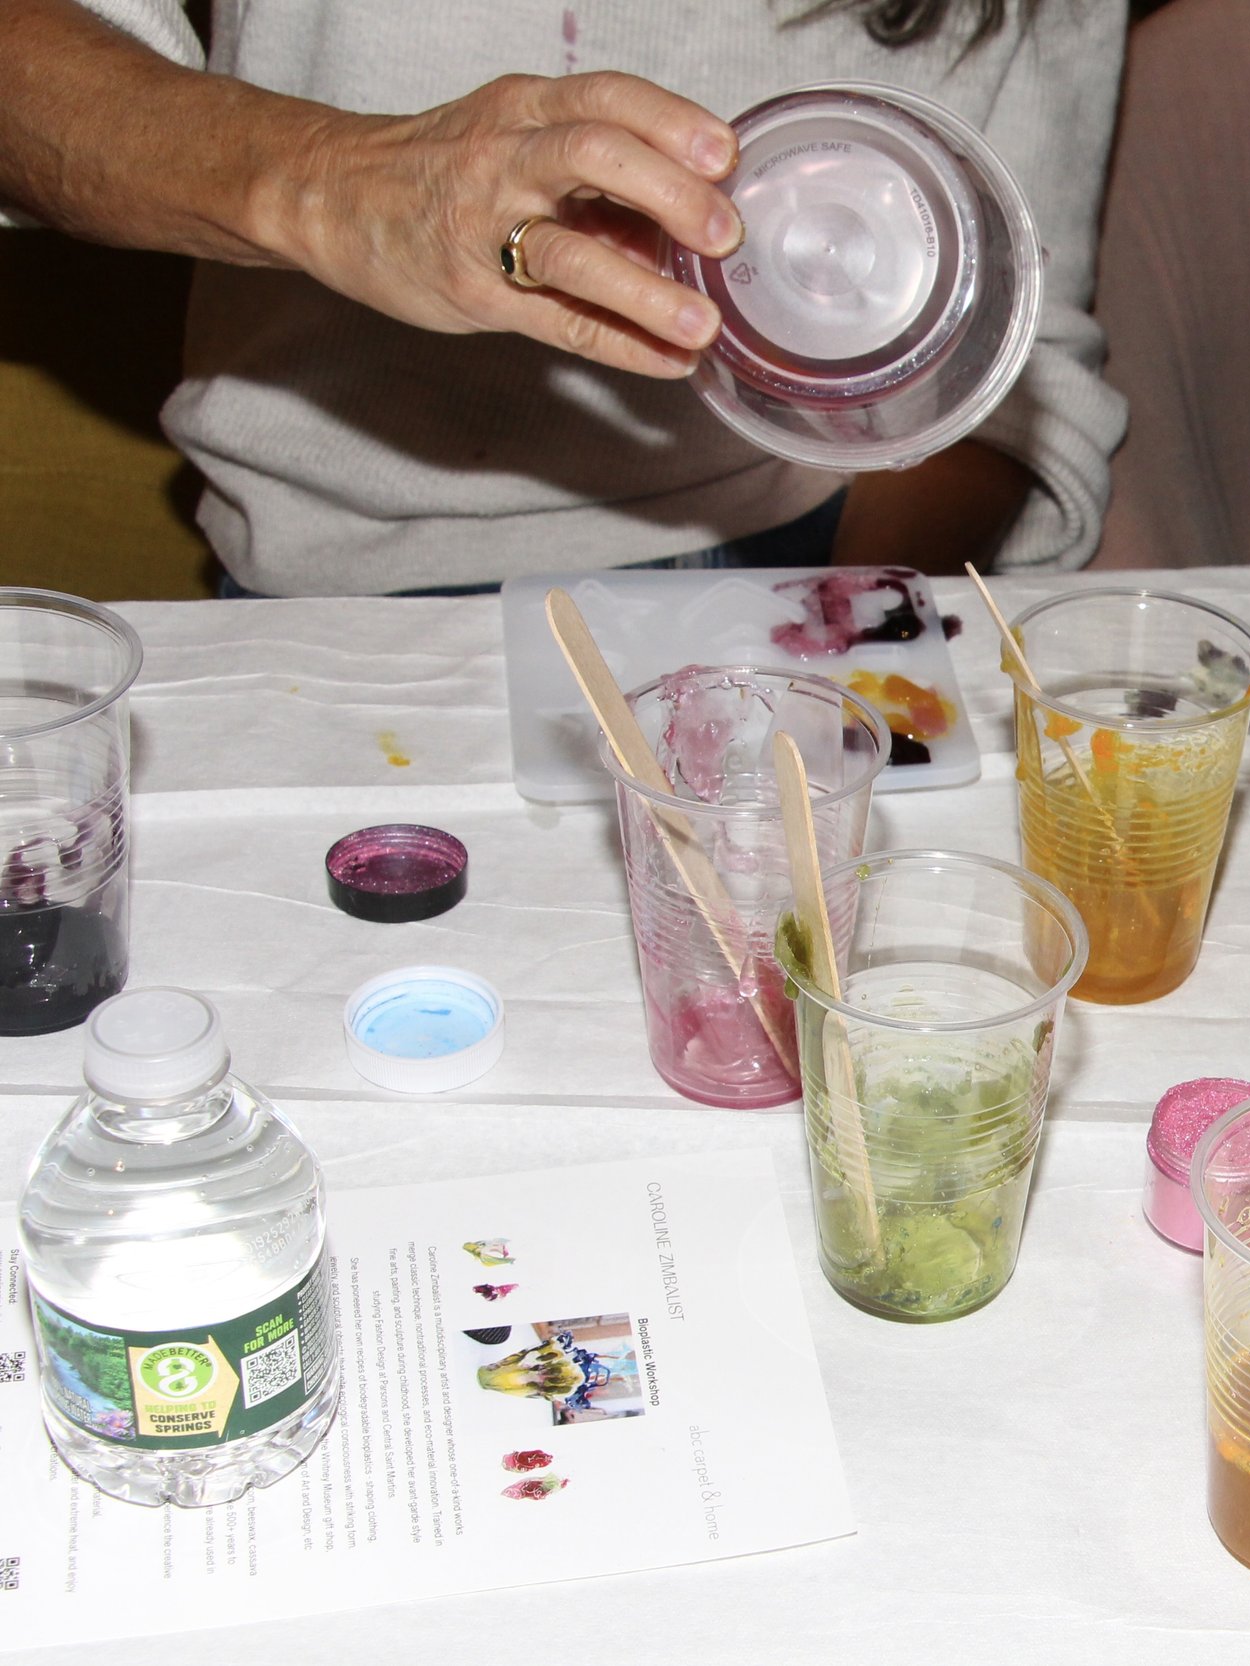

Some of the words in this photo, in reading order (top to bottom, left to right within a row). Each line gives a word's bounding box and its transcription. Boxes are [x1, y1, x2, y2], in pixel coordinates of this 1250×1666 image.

[753, 142, 819, 178] MICROWAVE
[821, 142, 852, 153] SAFE
[646, 1182, 671, 1249] CAROLINE
[8, 1249, 20, 1264] Stay
[350, 1257, 359, 1270] She
[389, 1248, 398, 1260] fine
[406, 1241, 416, 1262] merge
[427, 1246, 438, 1273] Caroline
[351, 1271, 359, 1284] has
[390, 1262, 398, 1276] arts,
[409, 1263, 420, 1286] classic
[390, 1277, 400, 1305] painting,
[430, 1274, 441, 1303] Zimbalist
[658, 1253, 685, 1321] ZIMBALIST
[350, 1284, 362, 1318] pioneered
[371, 1290, 383, 1319] studying
[393, 1306, 403, 1319] and
[244, 1336, 265, 1354] FOR
[267, 1317, 294, 1343] MORE
[255, 1313, 283, 1337] SCAN
[354, 1319, 362, 1330] her
[375, 1319, 384, 1345] Fashion
[394, 1320, 405, 1351] sculpture
[355, 1332, 363, 1347] own
[435, 1317, 447, 1371] multidisciplinary
[637, 1318, 654, 1360] Bioplastic
[143, 1349, 169, 1371] MADE
[355, 1347, 365, 1373] recipes
[375, 1346, 386, 1371] Design
[396, 1352, 407, 1374] during
[358, 1374, 367, 1382] of
[418, 1369, 429, 1408] processes,
[440, 1372, 450, 1390] artist
[645, 1361, 660, 1406] Workshop
[379, 1379, 389, 1408] Parsons
[399, 1375, 410, 1412] childhood,
[442, 1391, 451, 1405] and
[144, 1403, 197, 1413] HELPING
[201, 1400, 217, 1411] TO
[150, 1410, 216, 1424] CONSERVE
[358, 1383, 371, 1434] biodegradable
[381, 1409, 390, 1423] and
[402, 1412, 411, 1426] she
[423, 1409, 432, 1423] and
[155, 1420, 212, 1434] SPRINGS
[442, 1405, 453, 1436] designer
[320, 1438, 329, 1450] the
[382, 1424, 393, 1450] Central
[403, 1427, 415, 1466] developed
[424, 1424, 437, 1469] eco-material
[689, 1425, 710, 1446] abc
[361, 1435, 373, 1475] bioplastics
[384, 1451, 395, 1470] Saint
[447, 1437, 456, 1462] whose
[300, 1470, 311, 1478] of
[320, 1451, 330, 1482] Whitney
[407, 1466, 415, 1479] her
[691, 1449, 714, 1487] carpet
[301, 1480, 311, 1491] Art
[365, 1480, 376, 1510] shaping
[386, 1470, 397, 1498] Martins.
[429, 1470, 440, 1509] innovation.
[449, 1463, 462, 1512] one-of-a-kind
[700, 1490, 722, 1503] &
[301, 1492, 311, 1507] and
[323, 1483, 333, 1515] Museum
[407, 1480, 420, 1523] avant-garde
[163, 1503, 173, 1533] erience
[301, 1507, 312, 1536] Design,
[322, 1517, 334, 1529] gift
[367, 1511, 378, 1543] clothing,
[432, 1510, 443, 1538] Trained
[454, 1512, 464, 1536] works
[704, 1504, 723, 1540] home
[323, 1531, 335, 1553] shop,
[410, 1524, 422, 1543] style
[435, 1539, 445, 1547] in
